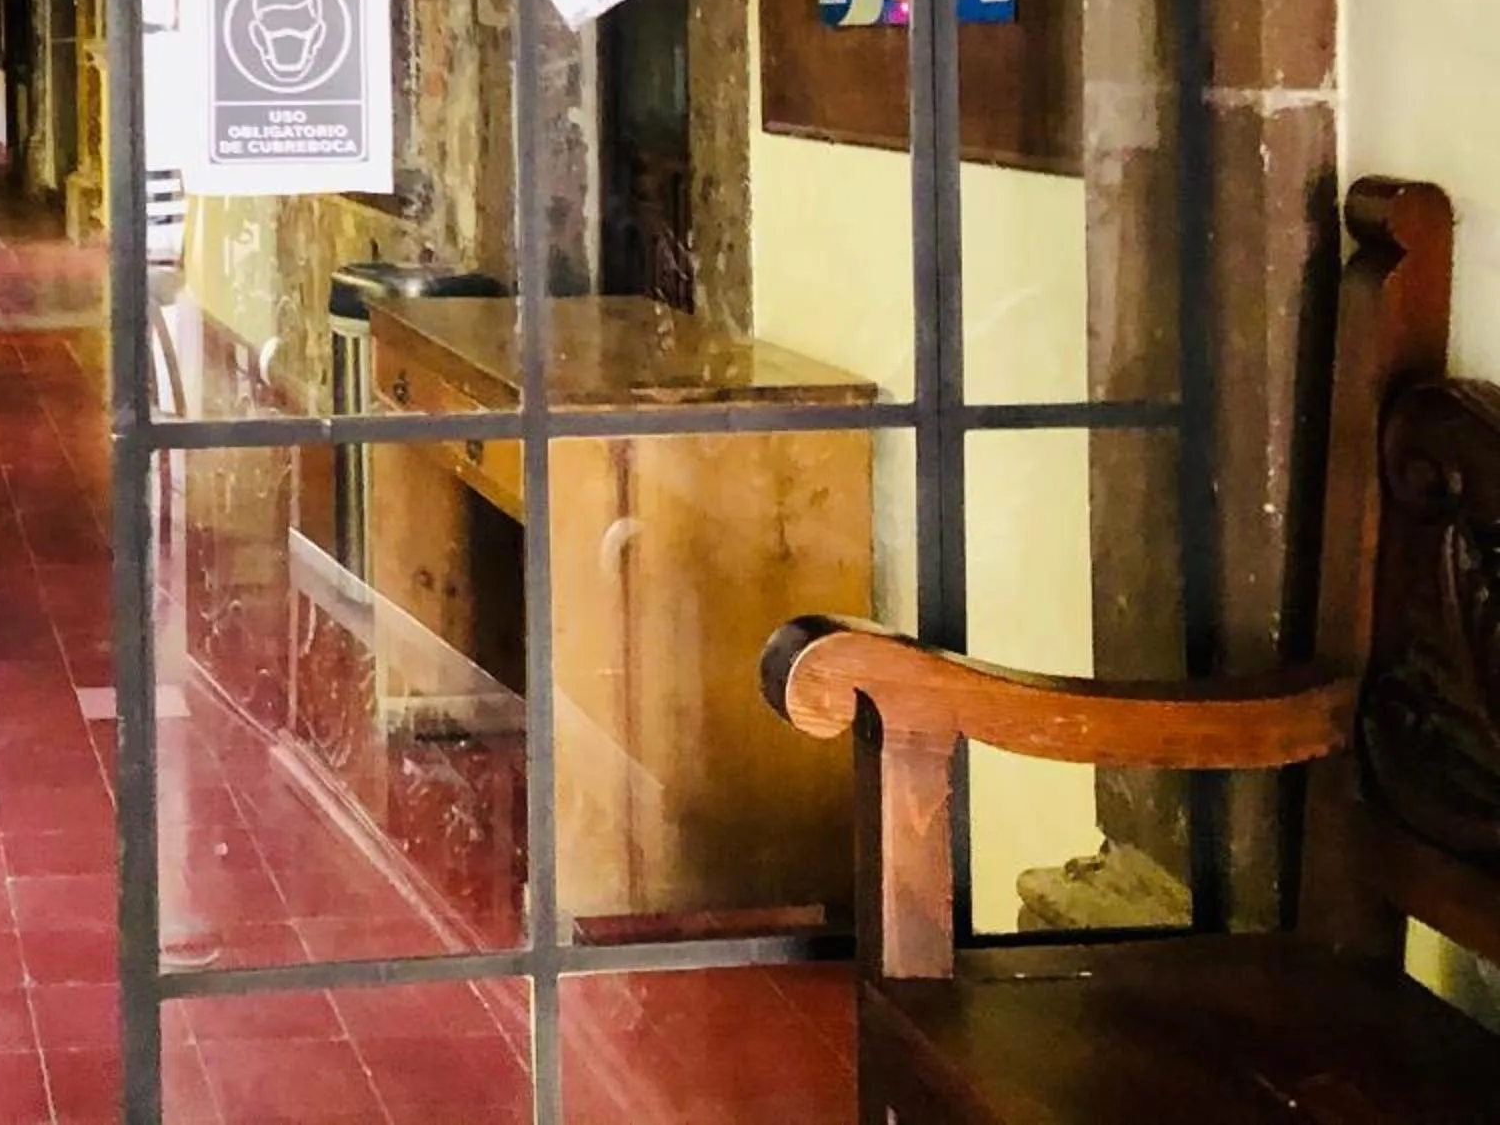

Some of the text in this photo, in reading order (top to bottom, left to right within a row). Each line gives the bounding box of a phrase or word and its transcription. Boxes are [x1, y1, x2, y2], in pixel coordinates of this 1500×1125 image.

[268, 110, 308, 124] USO
[227, 125, 349, 139] OBLIGATORIO
[219, 139, 358, 154] DE CUBREBOCA
